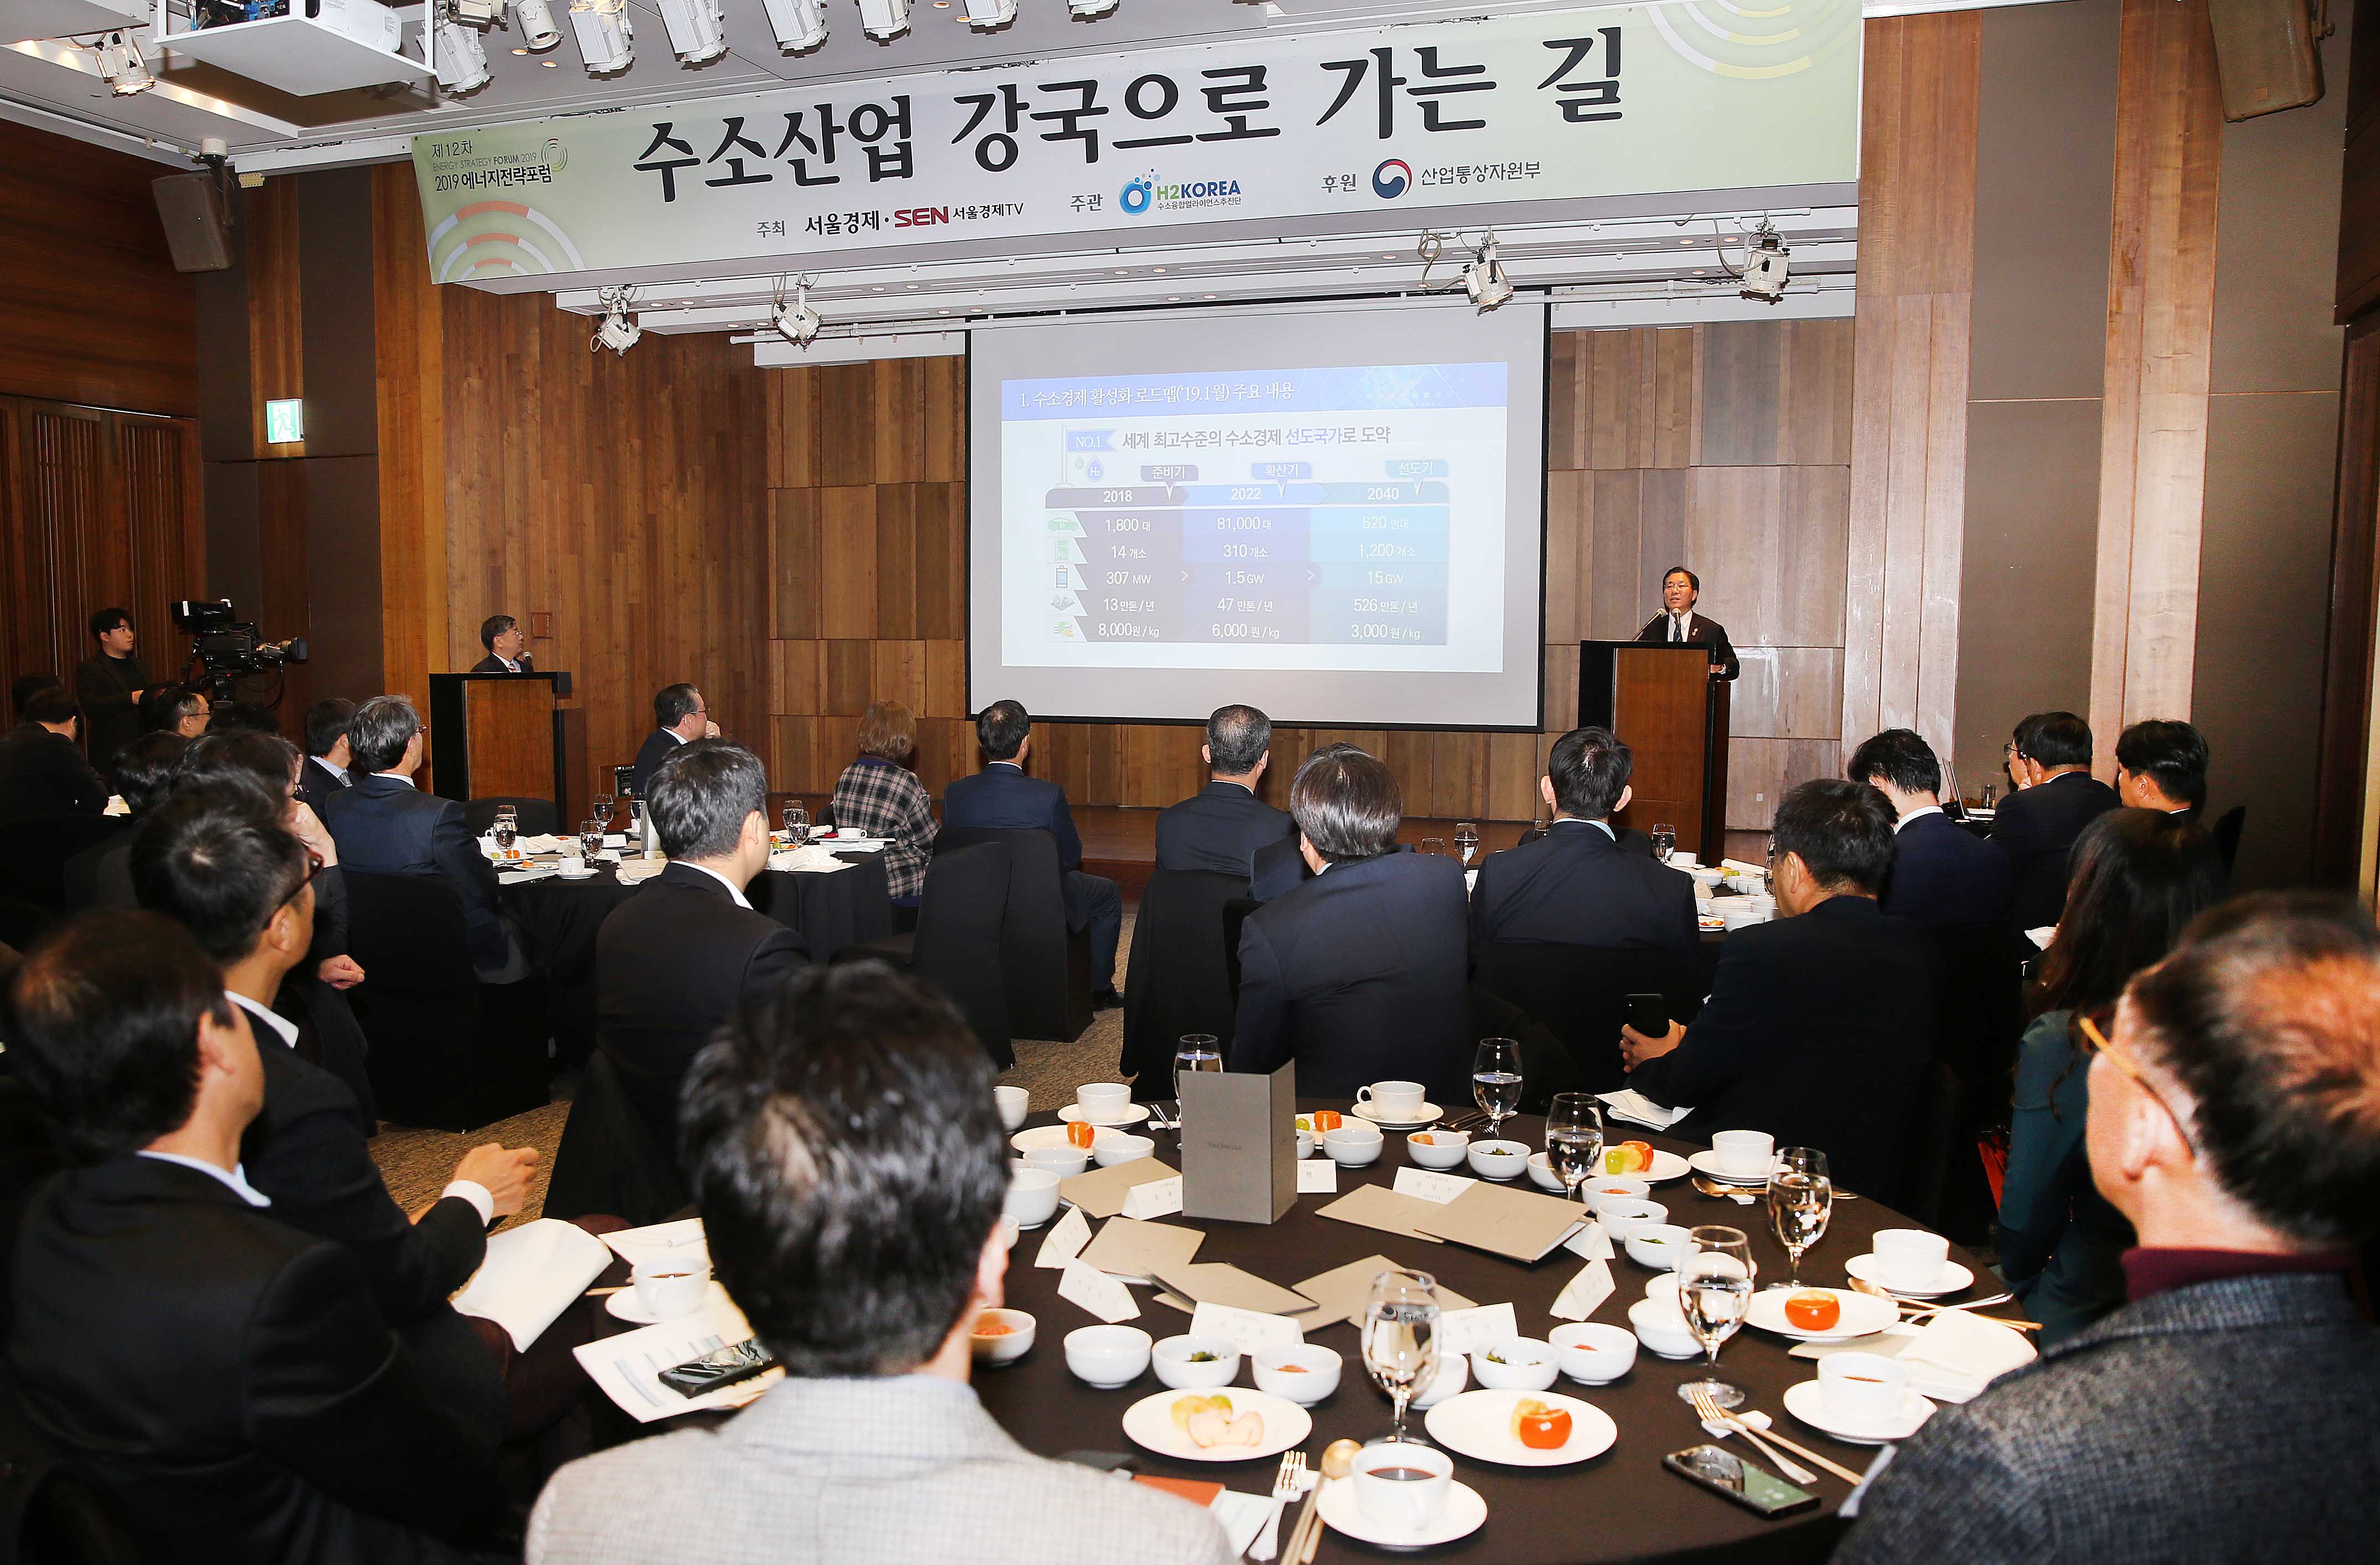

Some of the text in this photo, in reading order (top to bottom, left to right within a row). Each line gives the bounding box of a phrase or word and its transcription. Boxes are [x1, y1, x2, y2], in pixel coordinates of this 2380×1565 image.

[632, 26, 1623, 203] 수소산업 강국으로 가는 길
[432, 140, 473, 158] 제12차
[433, 152, 536, 172] ENERGY STRATEGY FORUM 2019
[434, 164, 552, 191] 2019 에너지전략포럼
[1421, 161, 1541, 186] 산업통상자원부
[1157, 180, 1241, 200] H2KOREA
[1321, 173, 1357, 193] 후원
[1070, 194, 1103, 213] 주관
[894, 206, 949, 228] SEN
[953, 203, 1024, 220] 서울경제TV
[757, 220, 785, 238] 주최
[1021, 393, 1030, 407] 1.
[1033, 388, 1088, 408] 수소경제
[1090, 387, 1133, 405] 활성화
[1233, 384, 1263, 400] 주요
[1265, 382, 1295, 400] 내용
[1075, 434, 1101, 448] NO.1
[1122, 426, 1391, 449] 세계 최고수준의 수소경제 선도국가로 도약
[1152, 466, 1186, 479] 준비기
[1265, 464, 1300, 477] 확산기
[1398, 461, 1433, 475] 선도기
[1103, 490, 1133, 503] 2018
[1230, 488, 1262, 500] 2022
[1367, 488, 1400, 501] 2040
[1106, 519, 1151, 533] 1,800 대
[1217, 517, 1272, 531] 81,000 대
[1362, 516, 1386, 530] 620
[1111, 546, 1147, 559] 14 개소
[1223, 544, 1268, 558] 310 개소
[1358, 543, 1394, 558] 1,200
[1106, 571, 1152, 584] 307 MW
[1225, 571, 1265, 584] 1.5 GW
[1367, 571, 1404, 584] 15 GW
[1104, 598, 1119, 611] 13
[1217, 598, 1234, 611] 47
[1354, 598, 1378, 612] 526
[1212, 623, 1248, 638] 6,000
[1351, 624, 1388, 639] 3,000
